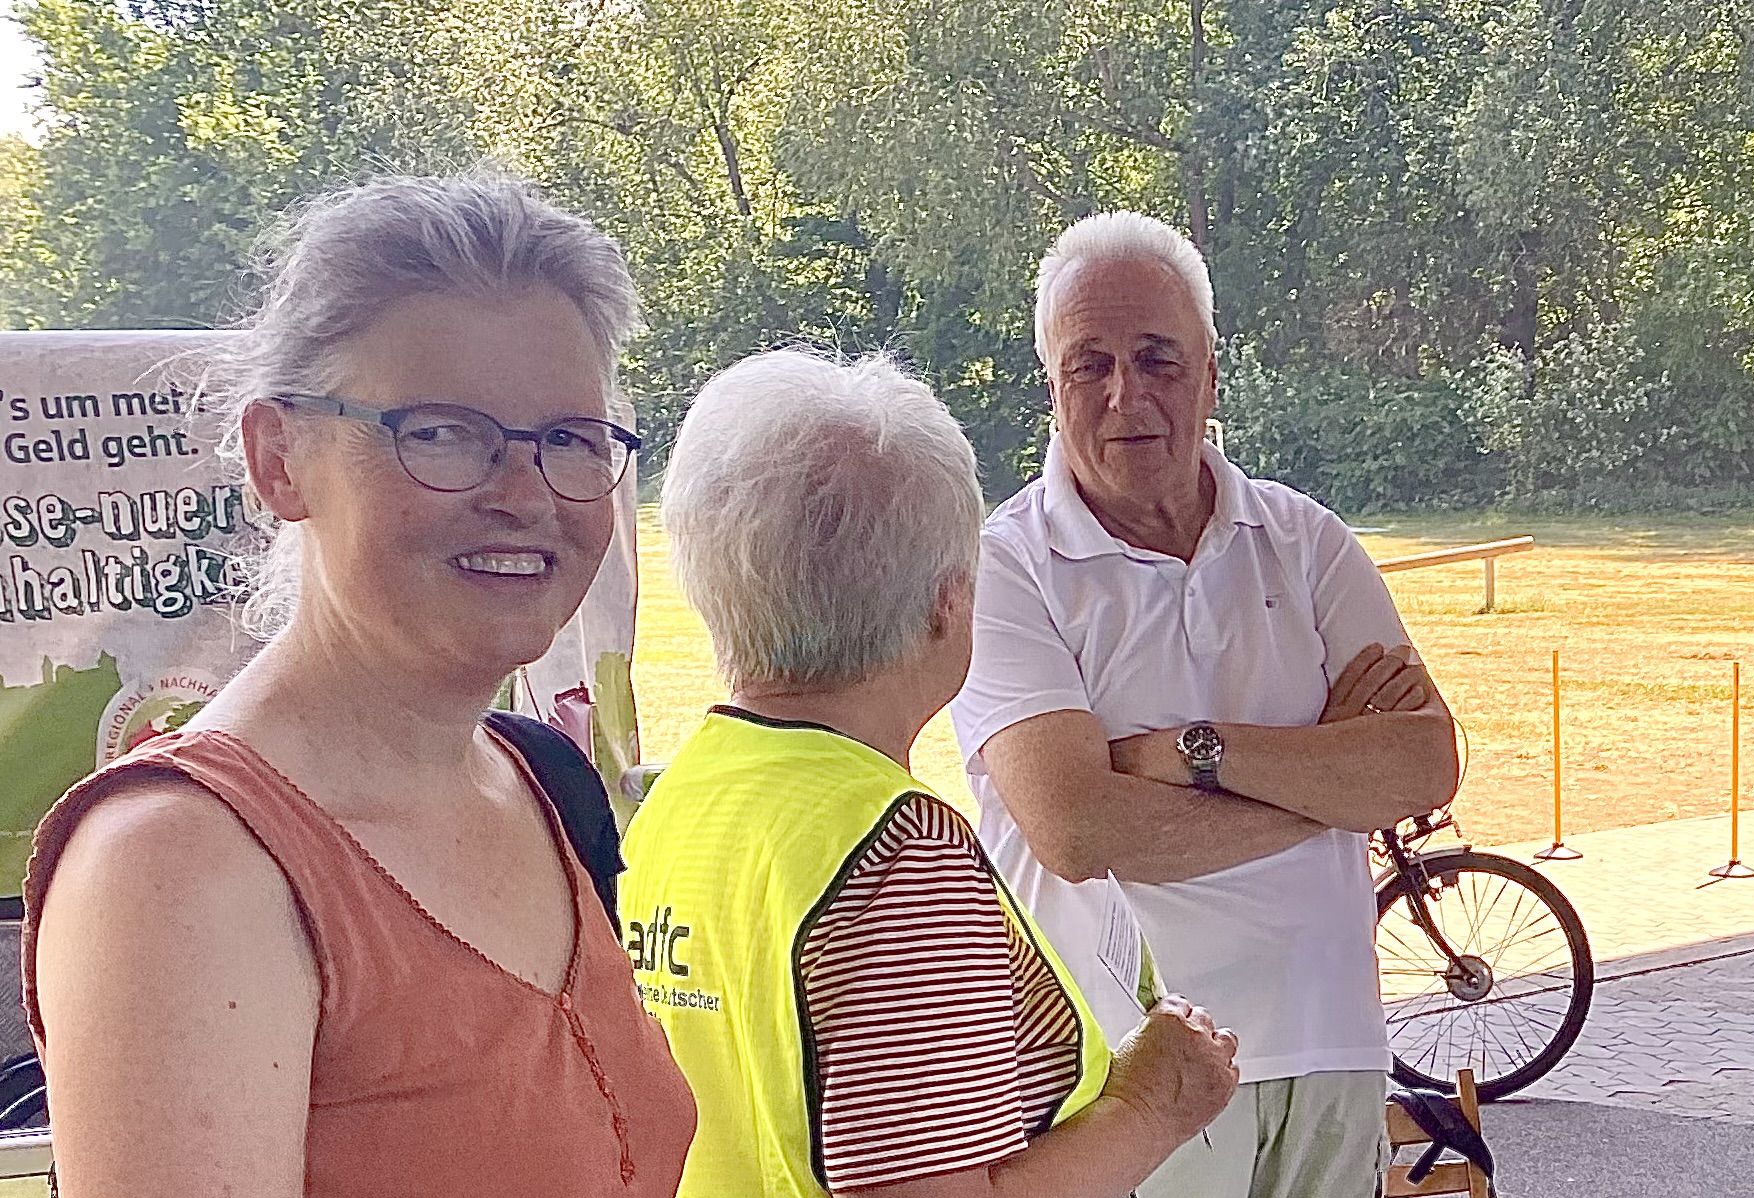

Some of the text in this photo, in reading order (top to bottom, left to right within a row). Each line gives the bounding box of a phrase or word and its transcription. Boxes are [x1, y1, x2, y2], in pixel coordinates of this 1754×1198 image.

[41, 395, 100, 419] um
[4, 425, 199, 468] Geld geht.
